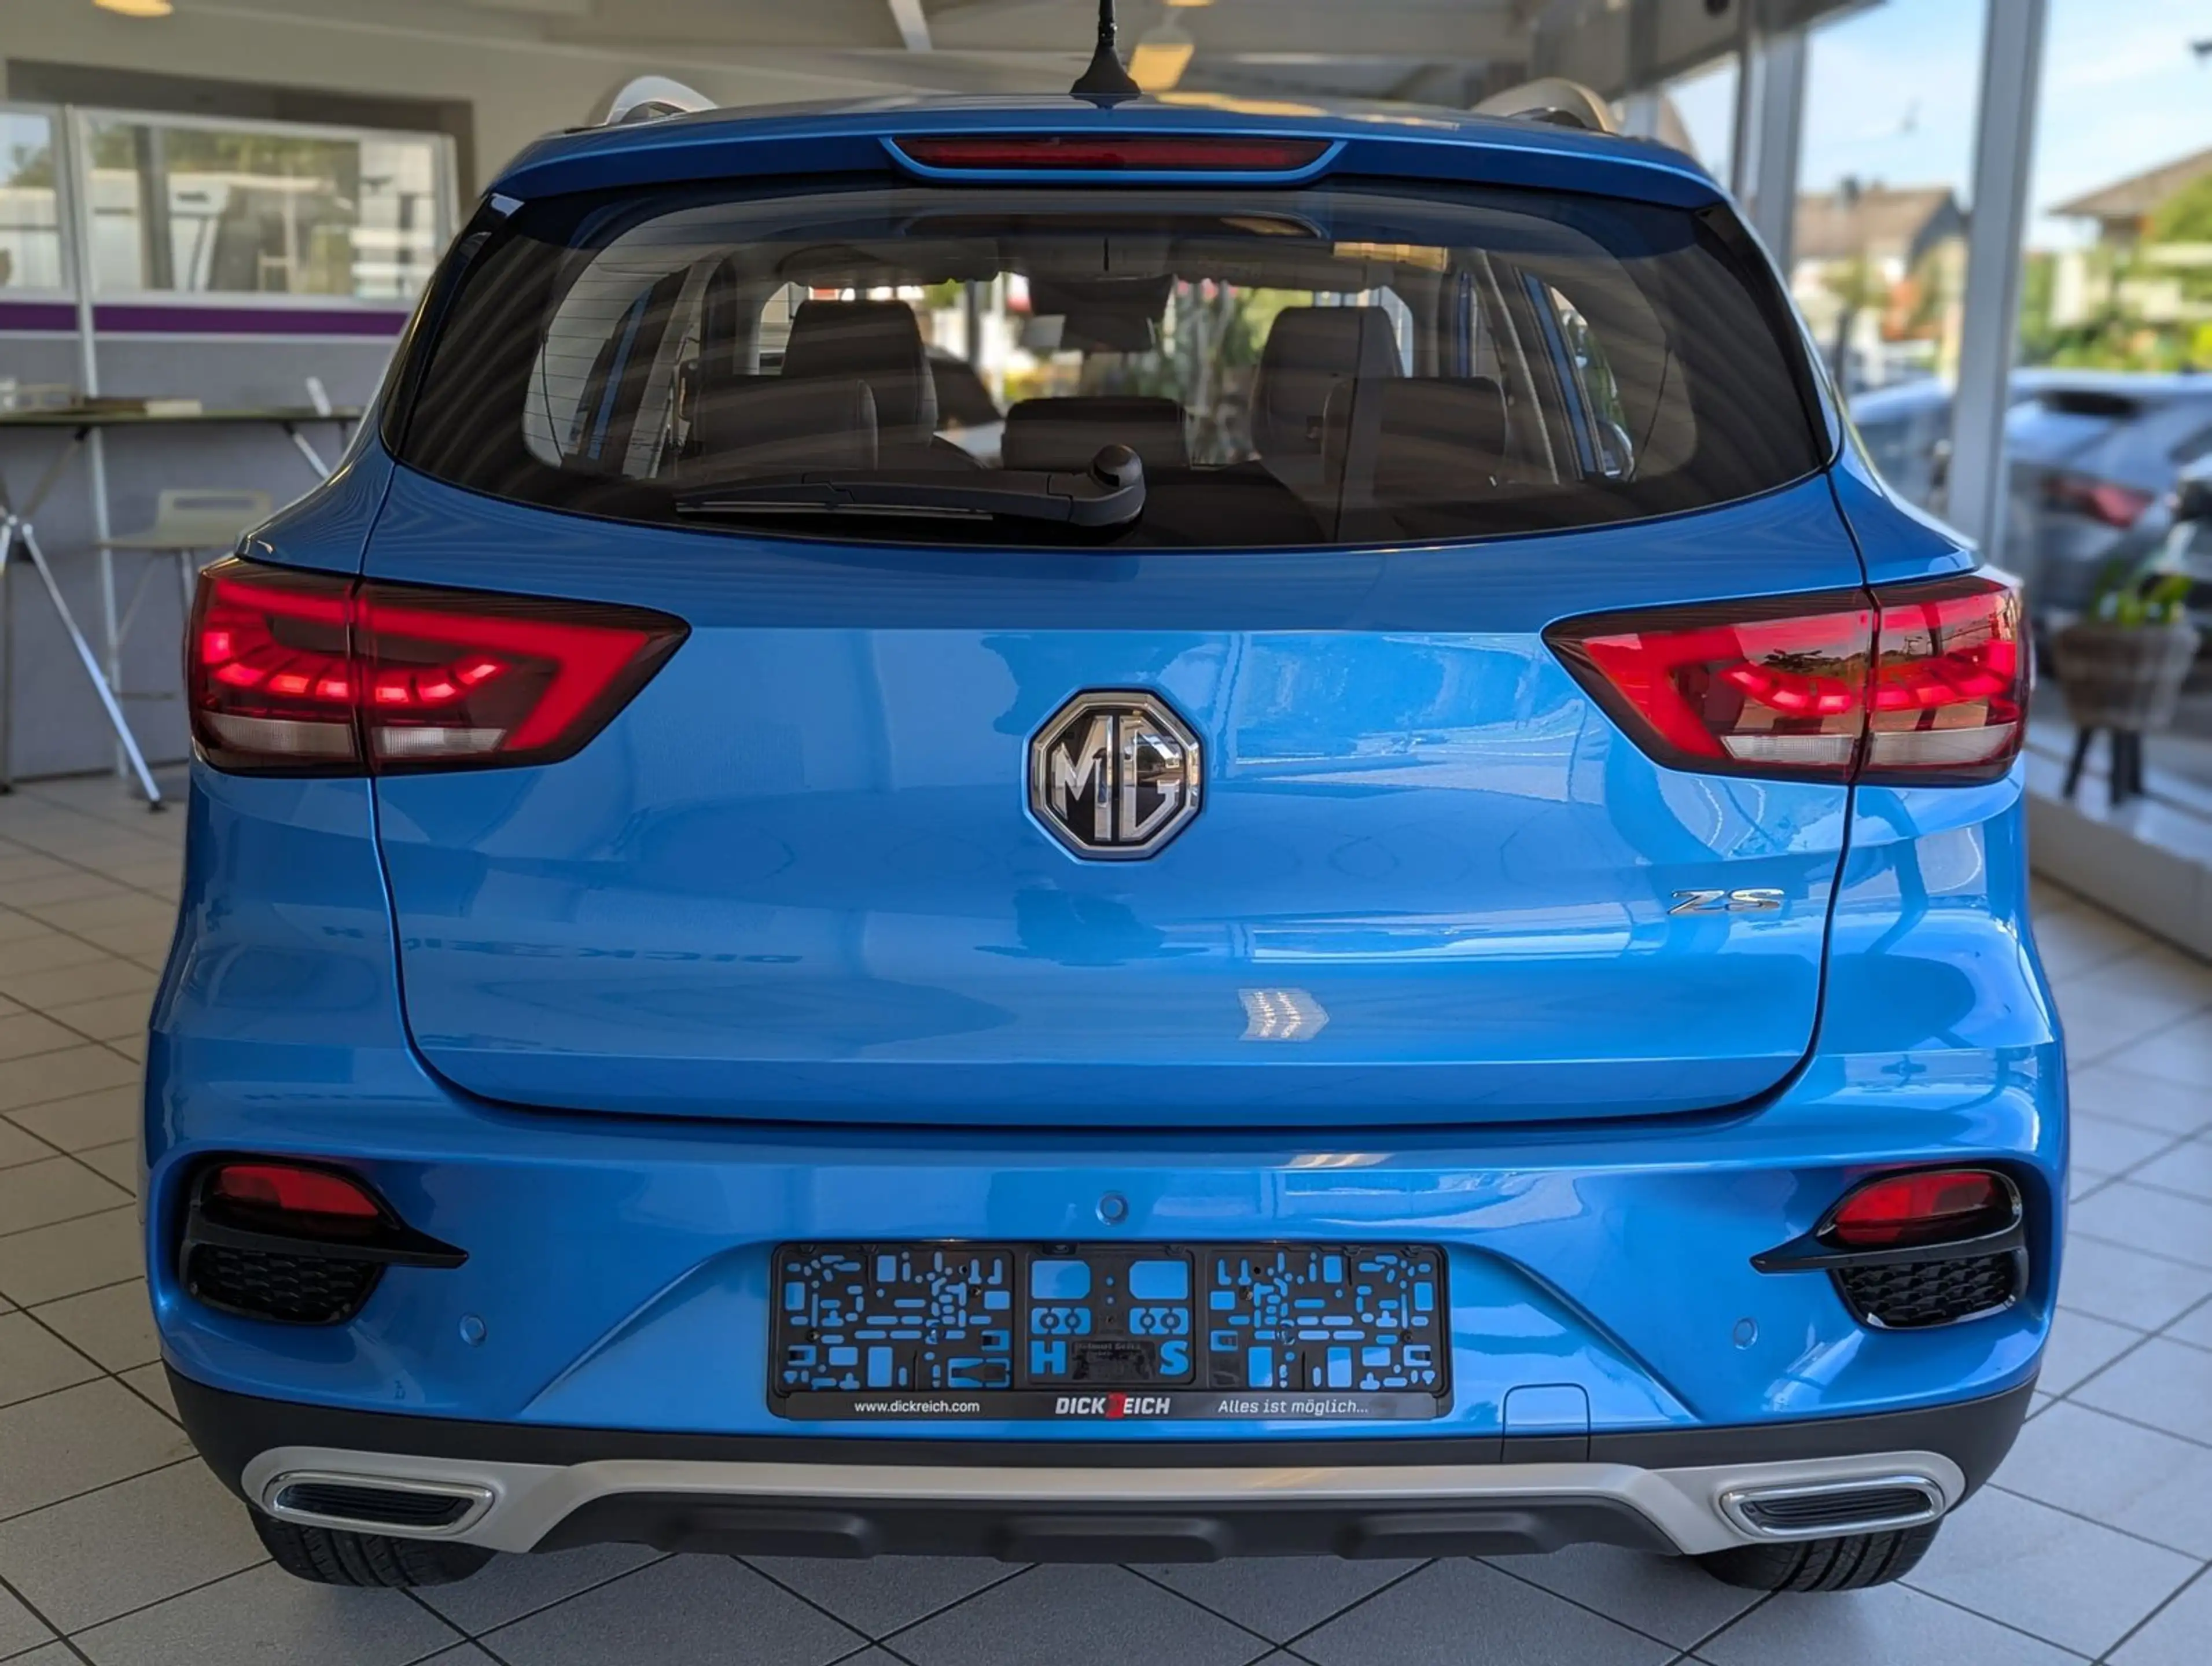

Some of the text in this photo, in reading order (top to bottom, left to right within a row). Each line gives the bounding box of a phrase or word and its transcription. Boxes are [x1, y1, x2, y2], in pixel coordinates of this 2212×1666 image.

[1051, 715, 1182, 841] MG
[1668, 889, 1784, 914] ZS
[854, 1399, 980, 1412] www.dickreich.com
[1218, 1399, 1368, 1416] Alles ist möglich...
